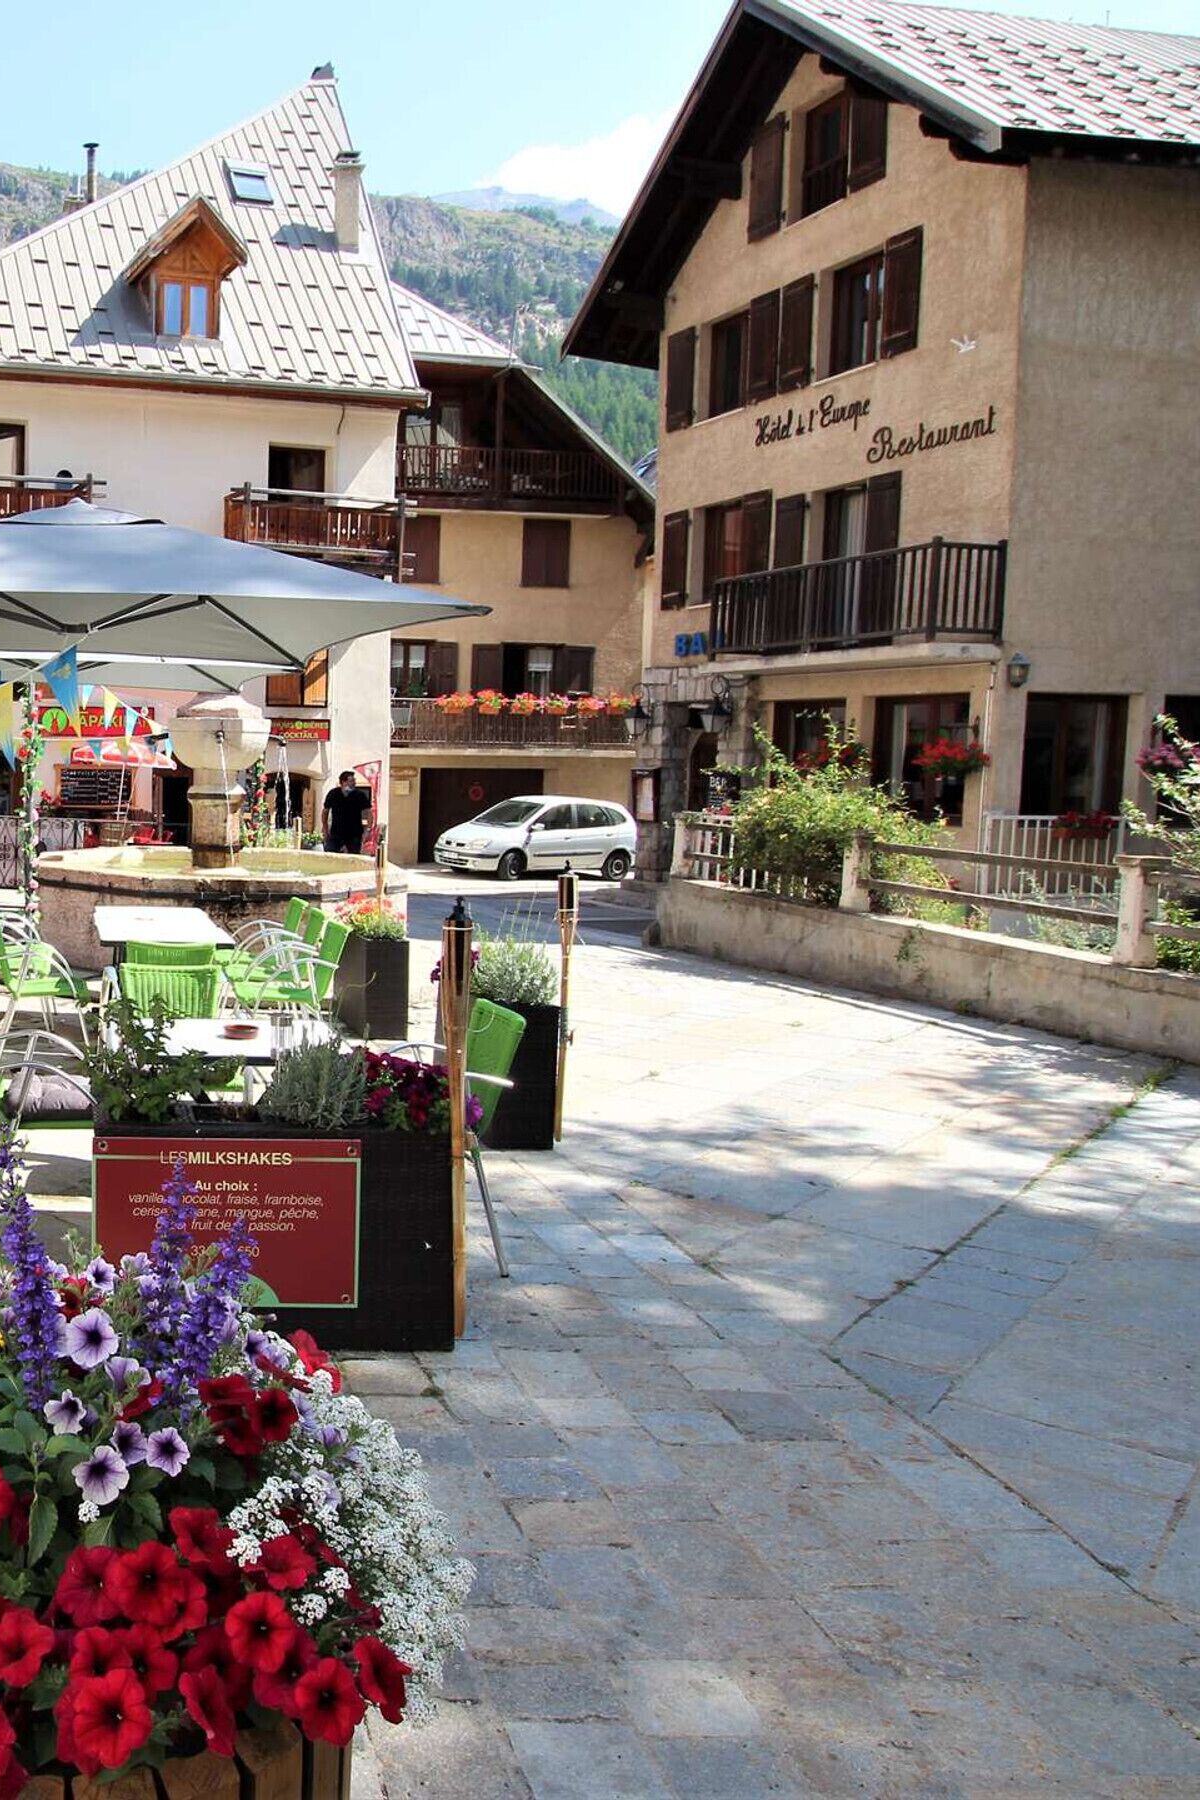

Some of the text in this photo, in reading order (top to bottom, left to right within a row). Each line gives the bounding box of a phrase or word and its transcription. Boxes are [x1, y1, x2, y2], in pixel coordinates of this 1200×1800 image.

[755, 408, 794, 448] Hôtel
[866, 405, 997, 464] Restaurant
[674, 631, 721, 657] BA
[195, 1180, 212, 1192] Au
[215, 1180, 249, 1192] choix
[226, 1194, 259, 1206] fraise,
[263, 1195, 324, 1207] framboise,
[224, 1208, 275, 1221] mangue,
[278, 1207, 320, 1222] pêche,
[191, 1219, 213, 1231] fruit
[215, 1219, 231, 1231] de
[247, 1220, 297, 1232] passion.
